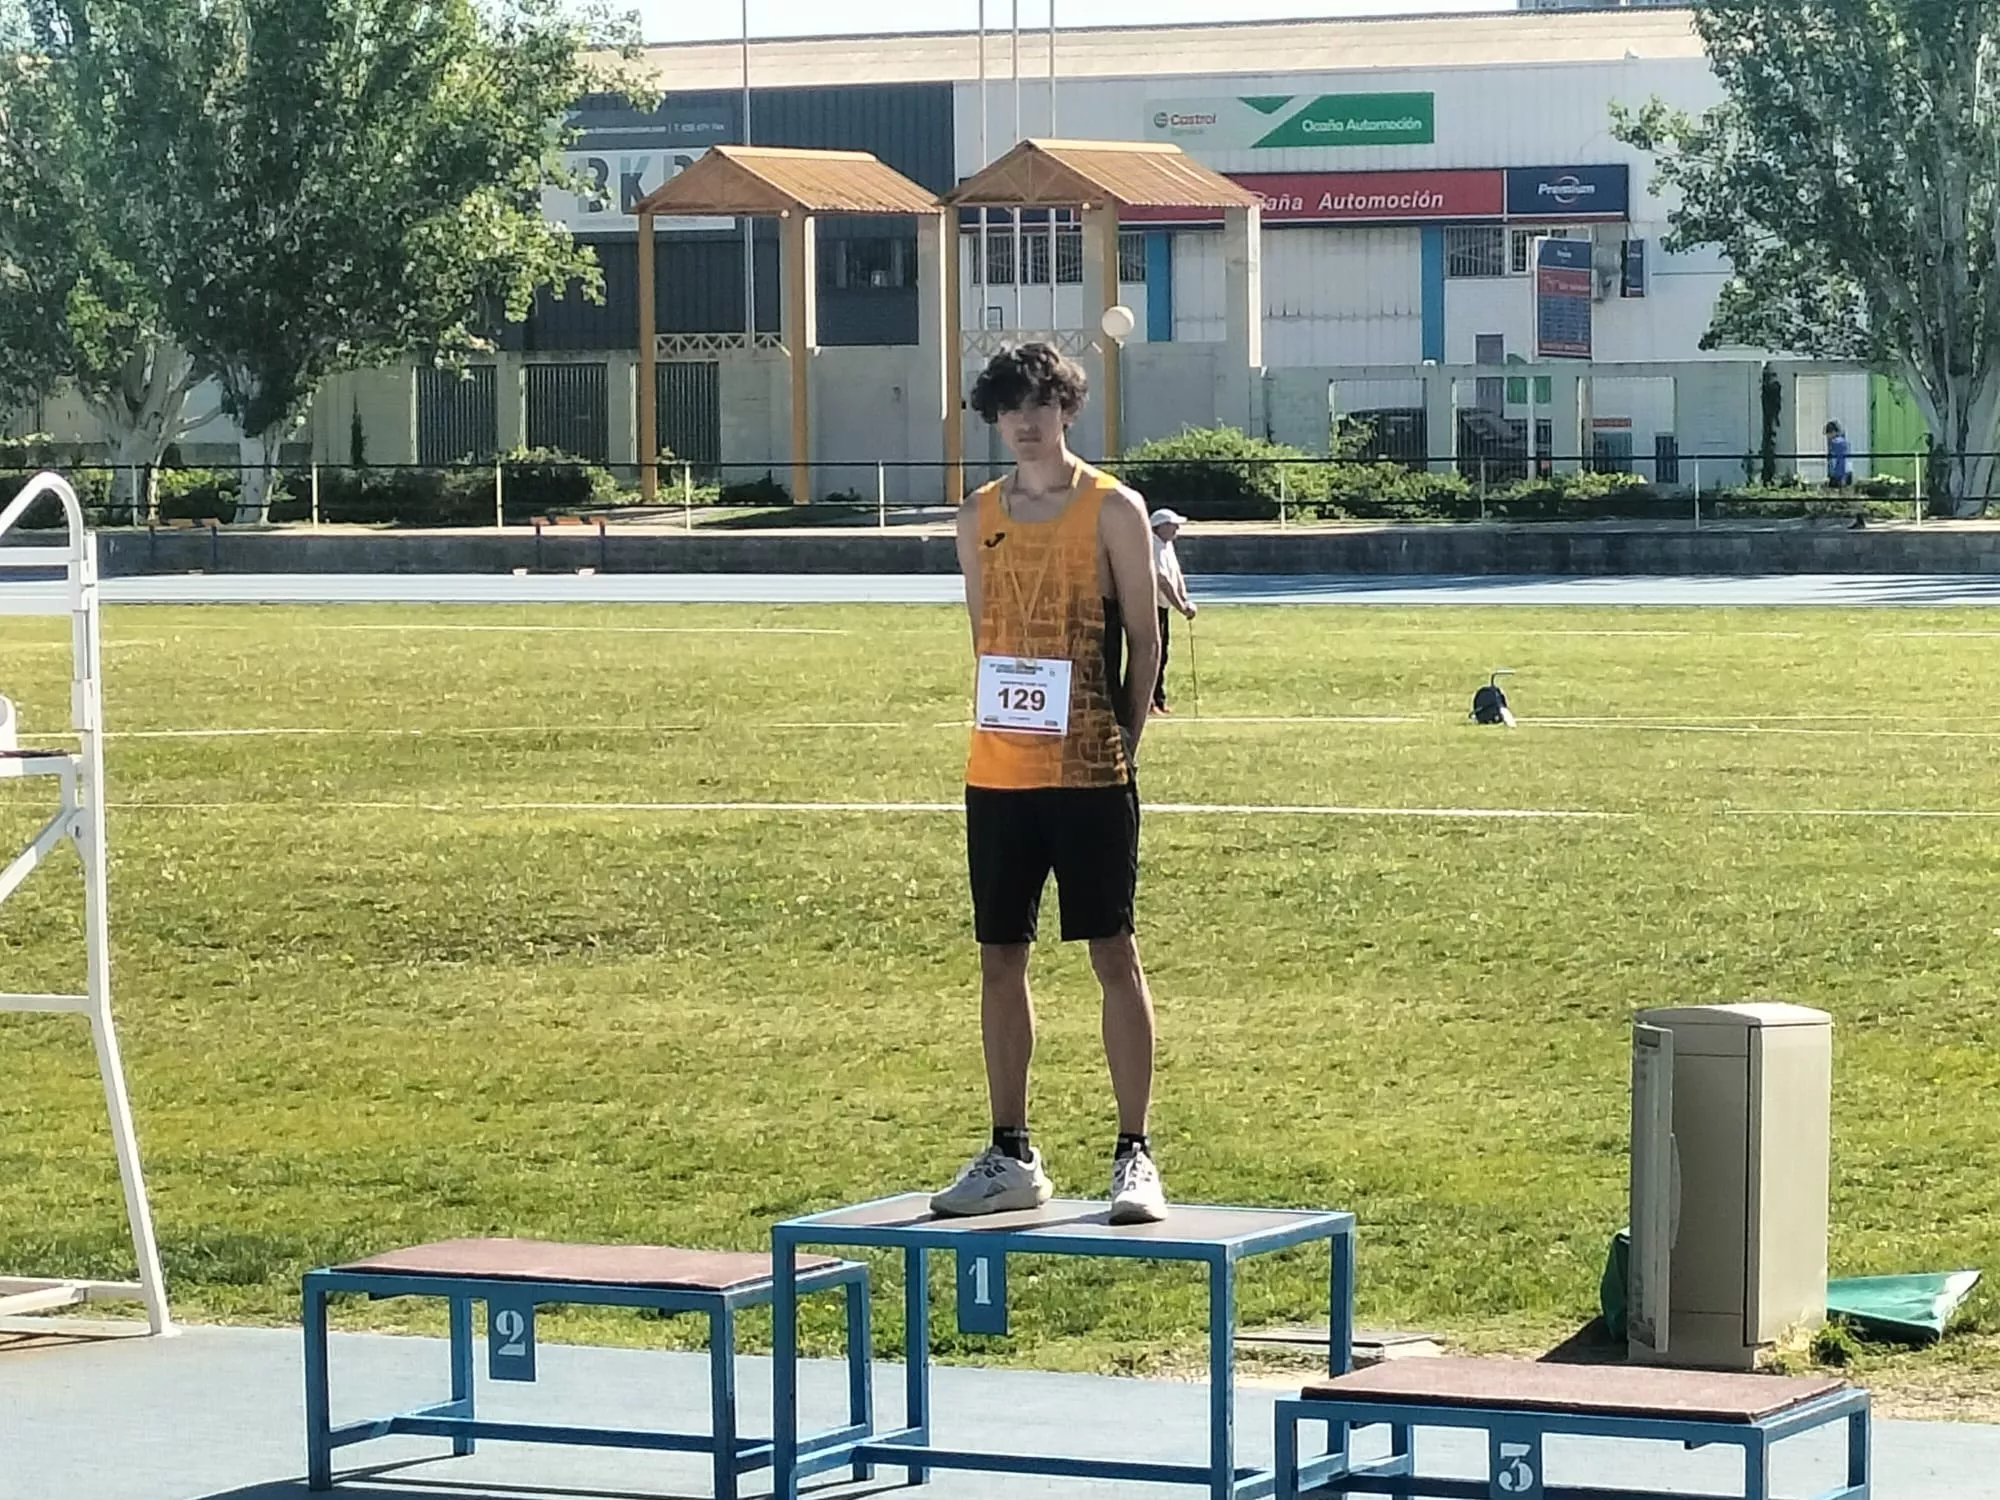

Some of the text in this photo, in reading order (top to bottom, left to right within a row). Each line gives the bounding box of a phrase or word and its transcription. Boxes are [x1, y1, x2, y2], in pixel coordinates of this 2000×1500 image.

[1170, 113, 1217, 126] Castrol
[1302, 116, 1422, 132] Ocaña Automoción
[1252, 190, 1444, 212] aña Automoción
[998, 687, 1046, 711] 129
[968, 1256, 992, 1305] 1
[495, 1309, 526, 1357] 2
[1498, 1442, 1534, 1492] 3
